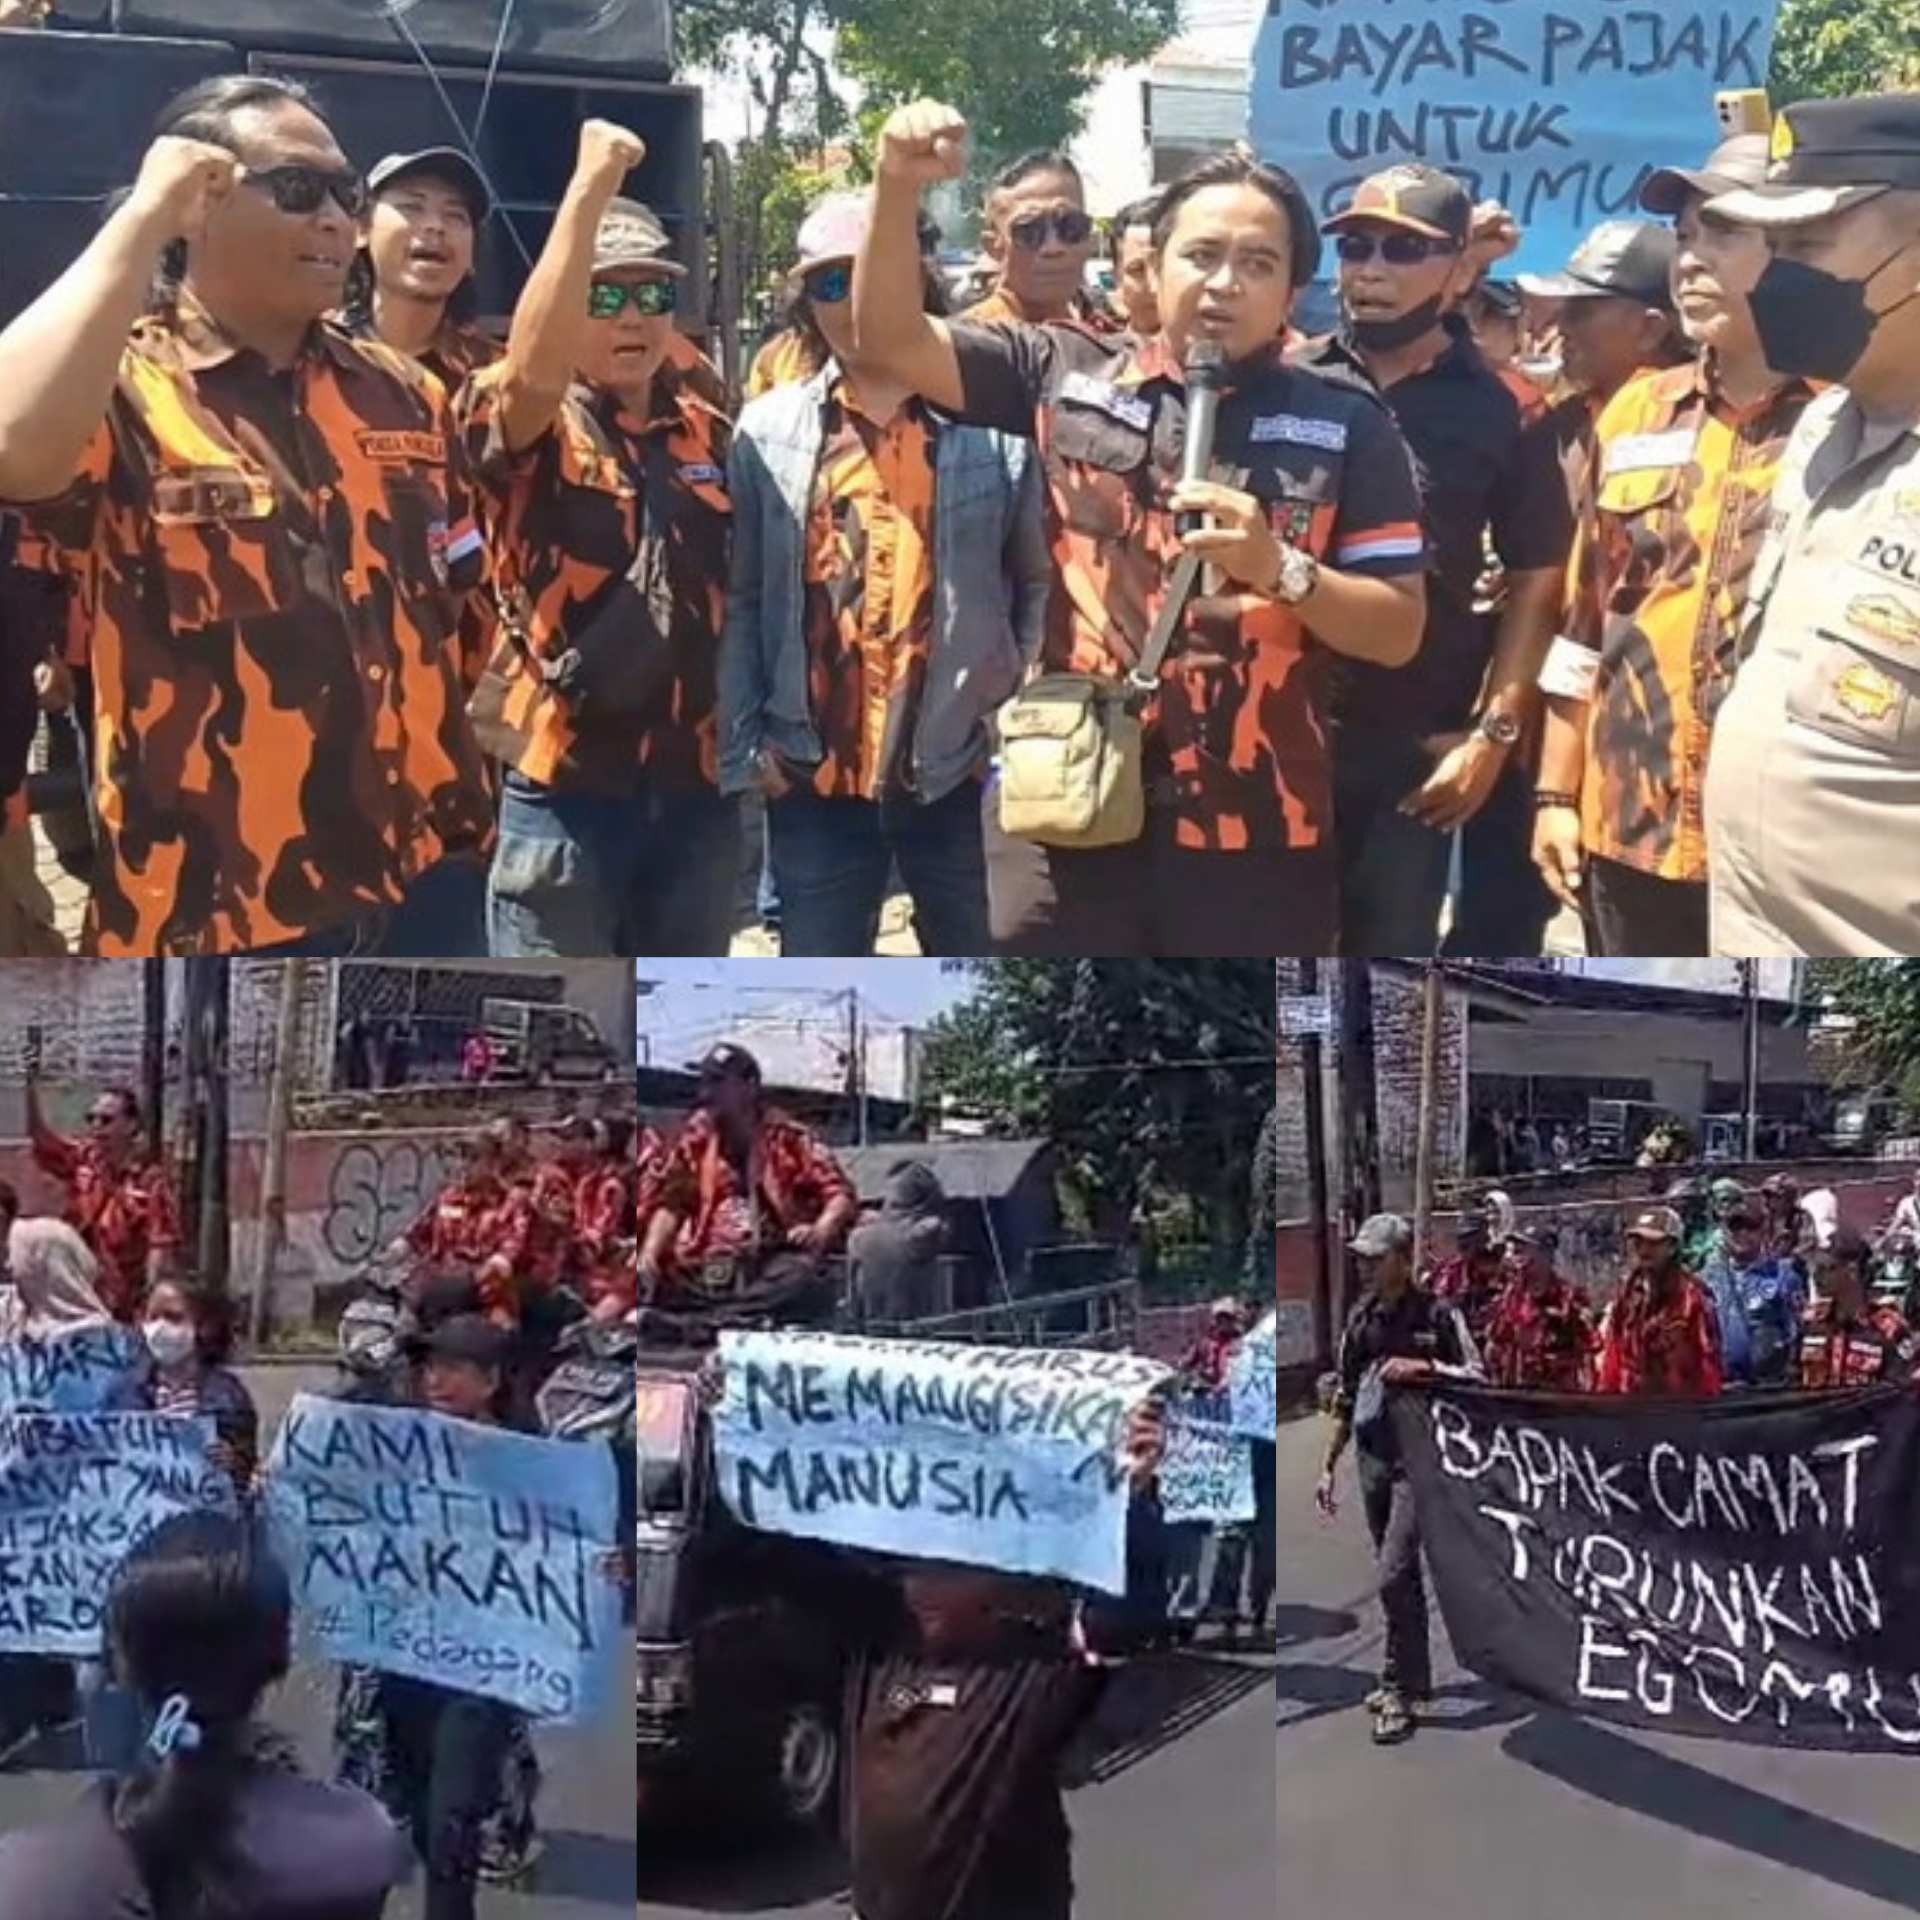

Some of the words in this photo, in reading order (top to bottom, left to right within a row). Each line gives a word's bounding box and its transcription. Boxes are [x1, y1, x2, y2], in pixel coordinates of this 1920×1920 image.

[1280, 13, 1528, 94] BAYAR
[1542, 14, 1763, 85] PAJAK
[1328, 102, 1572, 160] UNTUK
[1859, 535, 1920, 584] POL
[284, 1414, 462, 1486] KAMI
[736, 1447, 1027, 1520] MANUSIA
[1430, 1400, 1640, 1519] BAPAK
[1648, 1434, 1880, 1535] CAMAT
[302, 1475, 586, 1552] BUTUH
[303, 1534, 594, 1650] MAKAN
[1478, 1505, 1882, 1652] TURUNKAN
